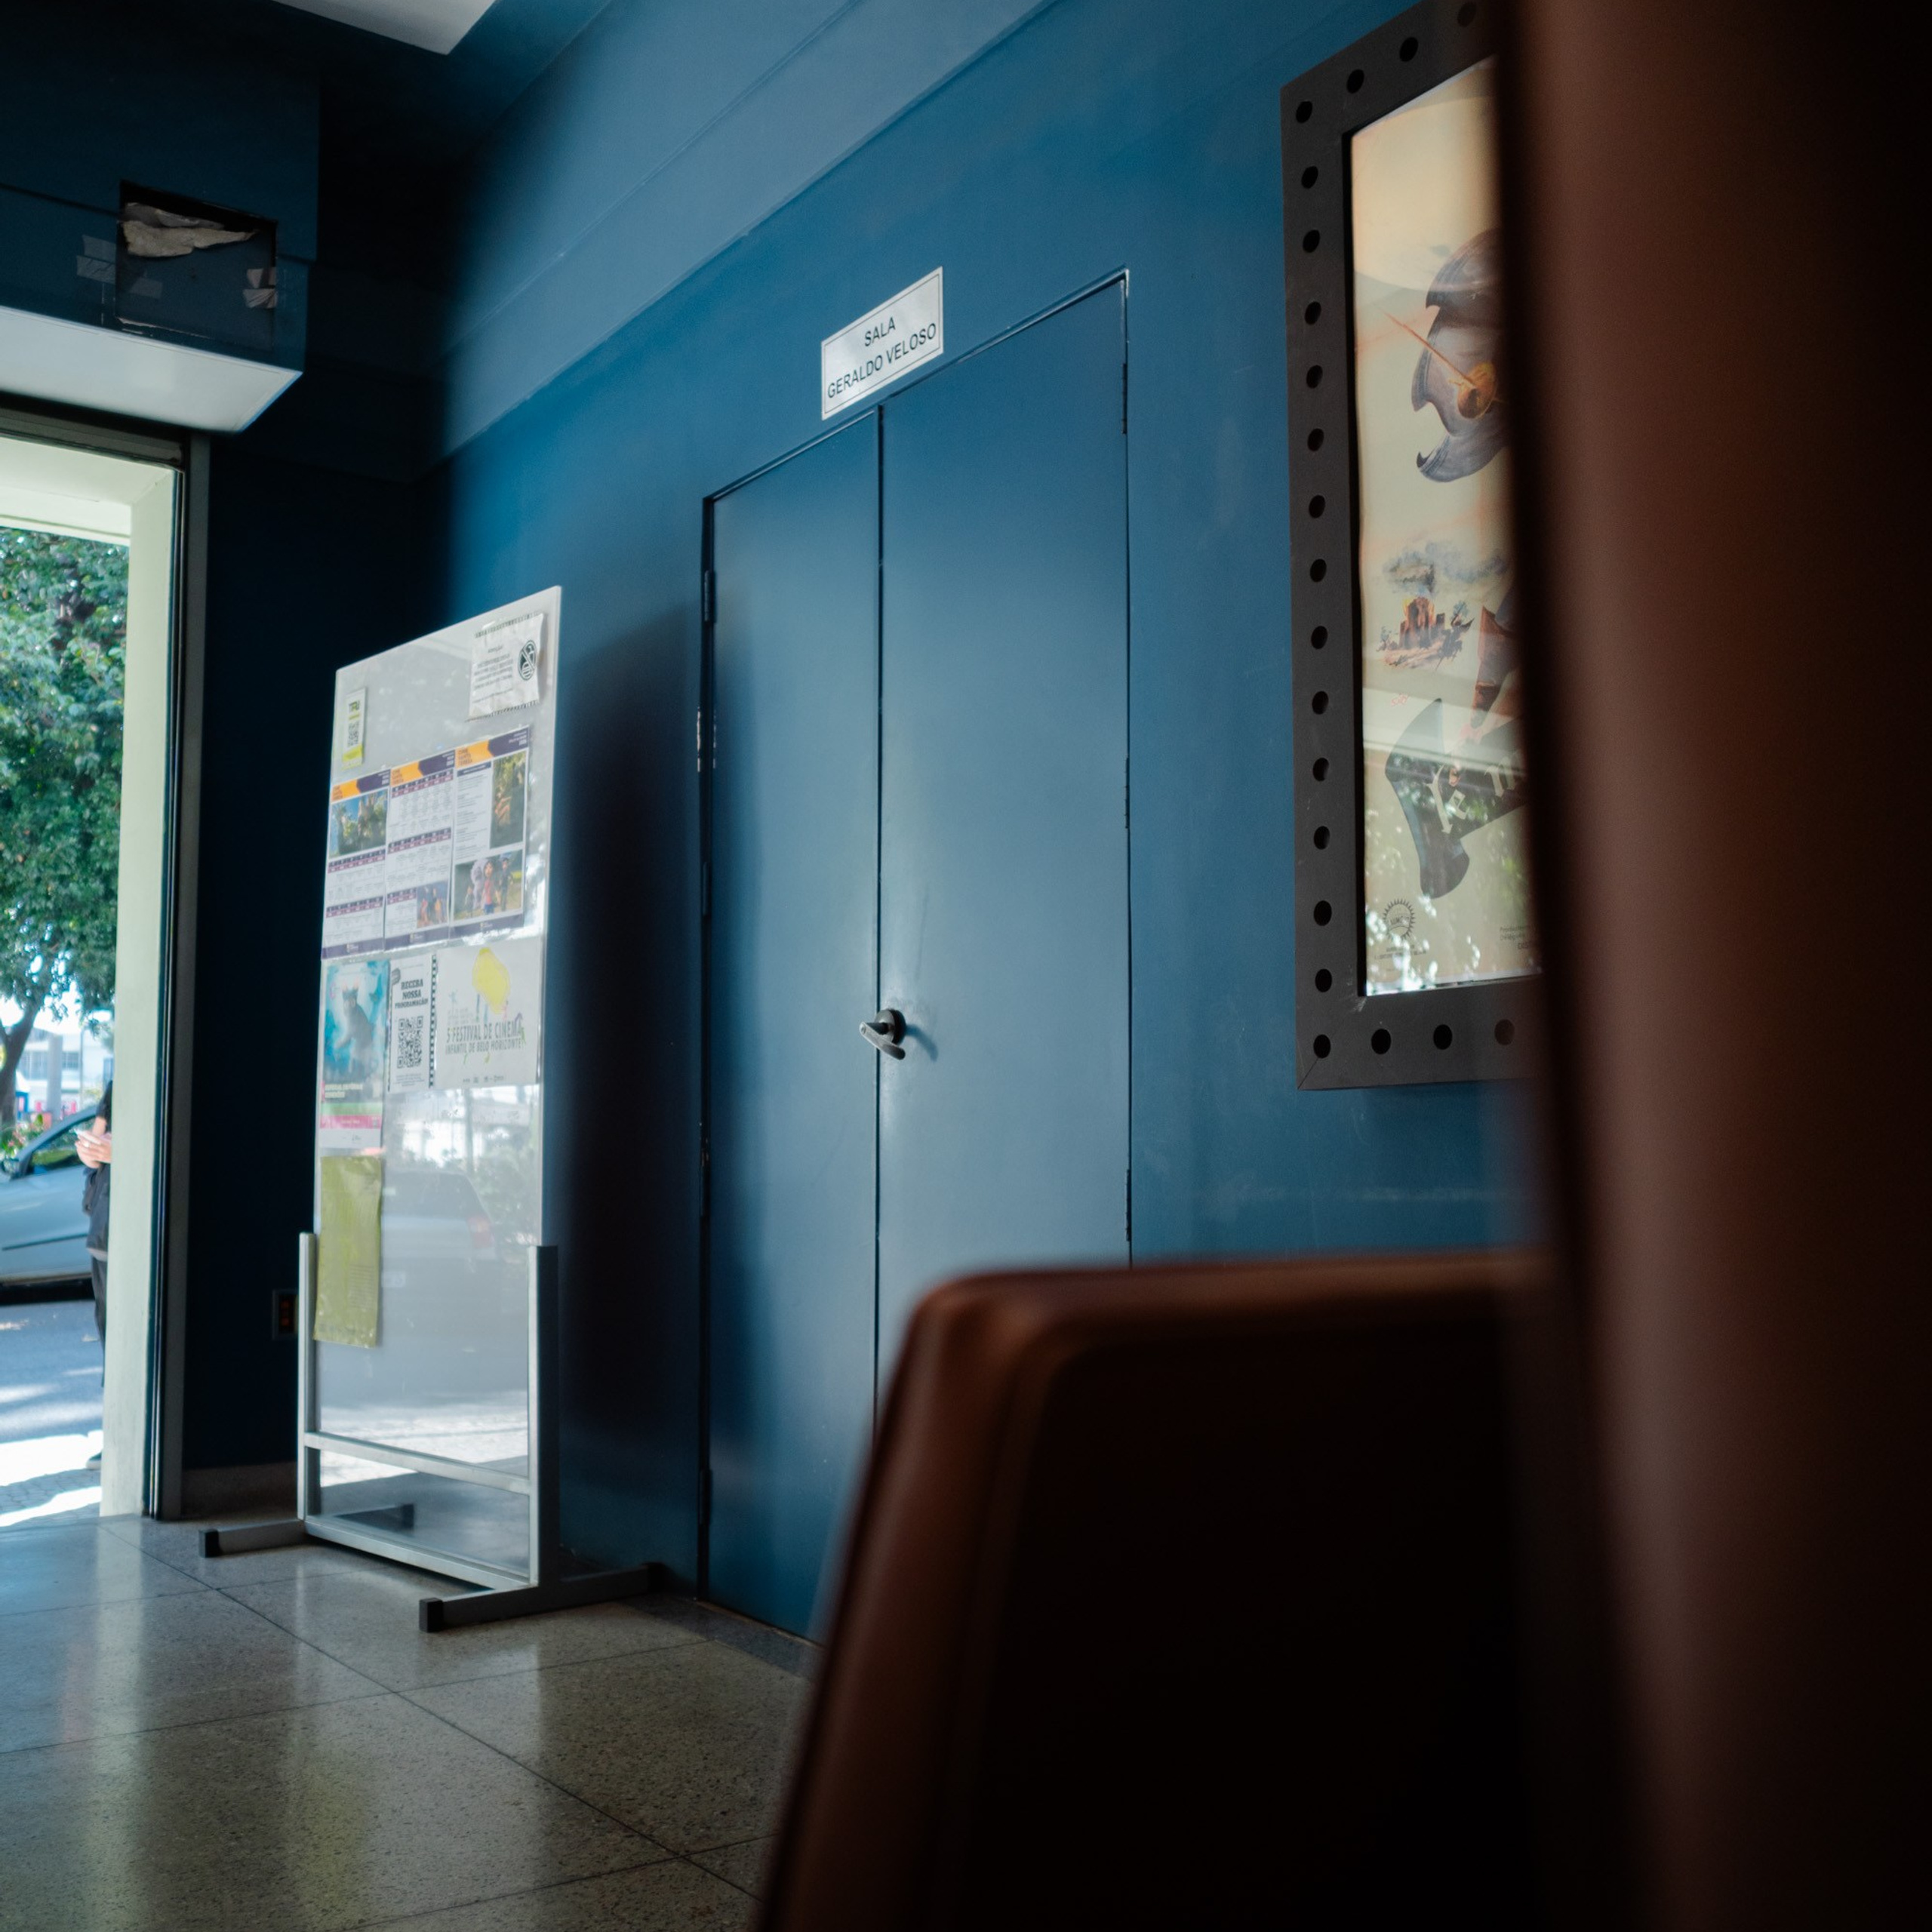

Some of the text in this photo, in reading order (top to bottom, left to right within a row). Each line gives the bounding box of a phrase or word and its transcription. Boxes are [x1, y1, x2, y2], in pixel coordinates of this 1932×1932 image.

[864, 317, 896, 347] SALA
[827, 323, 937, 398] GERALDO VELOSO
[401, 979, 423, 989] RECEBA
[402, 989, 421, 999] NOSSA
[452, 1024, 481, 1042] FESTIVAL
[484, 1023, 492, 1040] DE
[494, 1019, 521, 1039] CINEMA
[445, 1038, 521, 1055] INFANTIL DE BELO HORIZONTE
